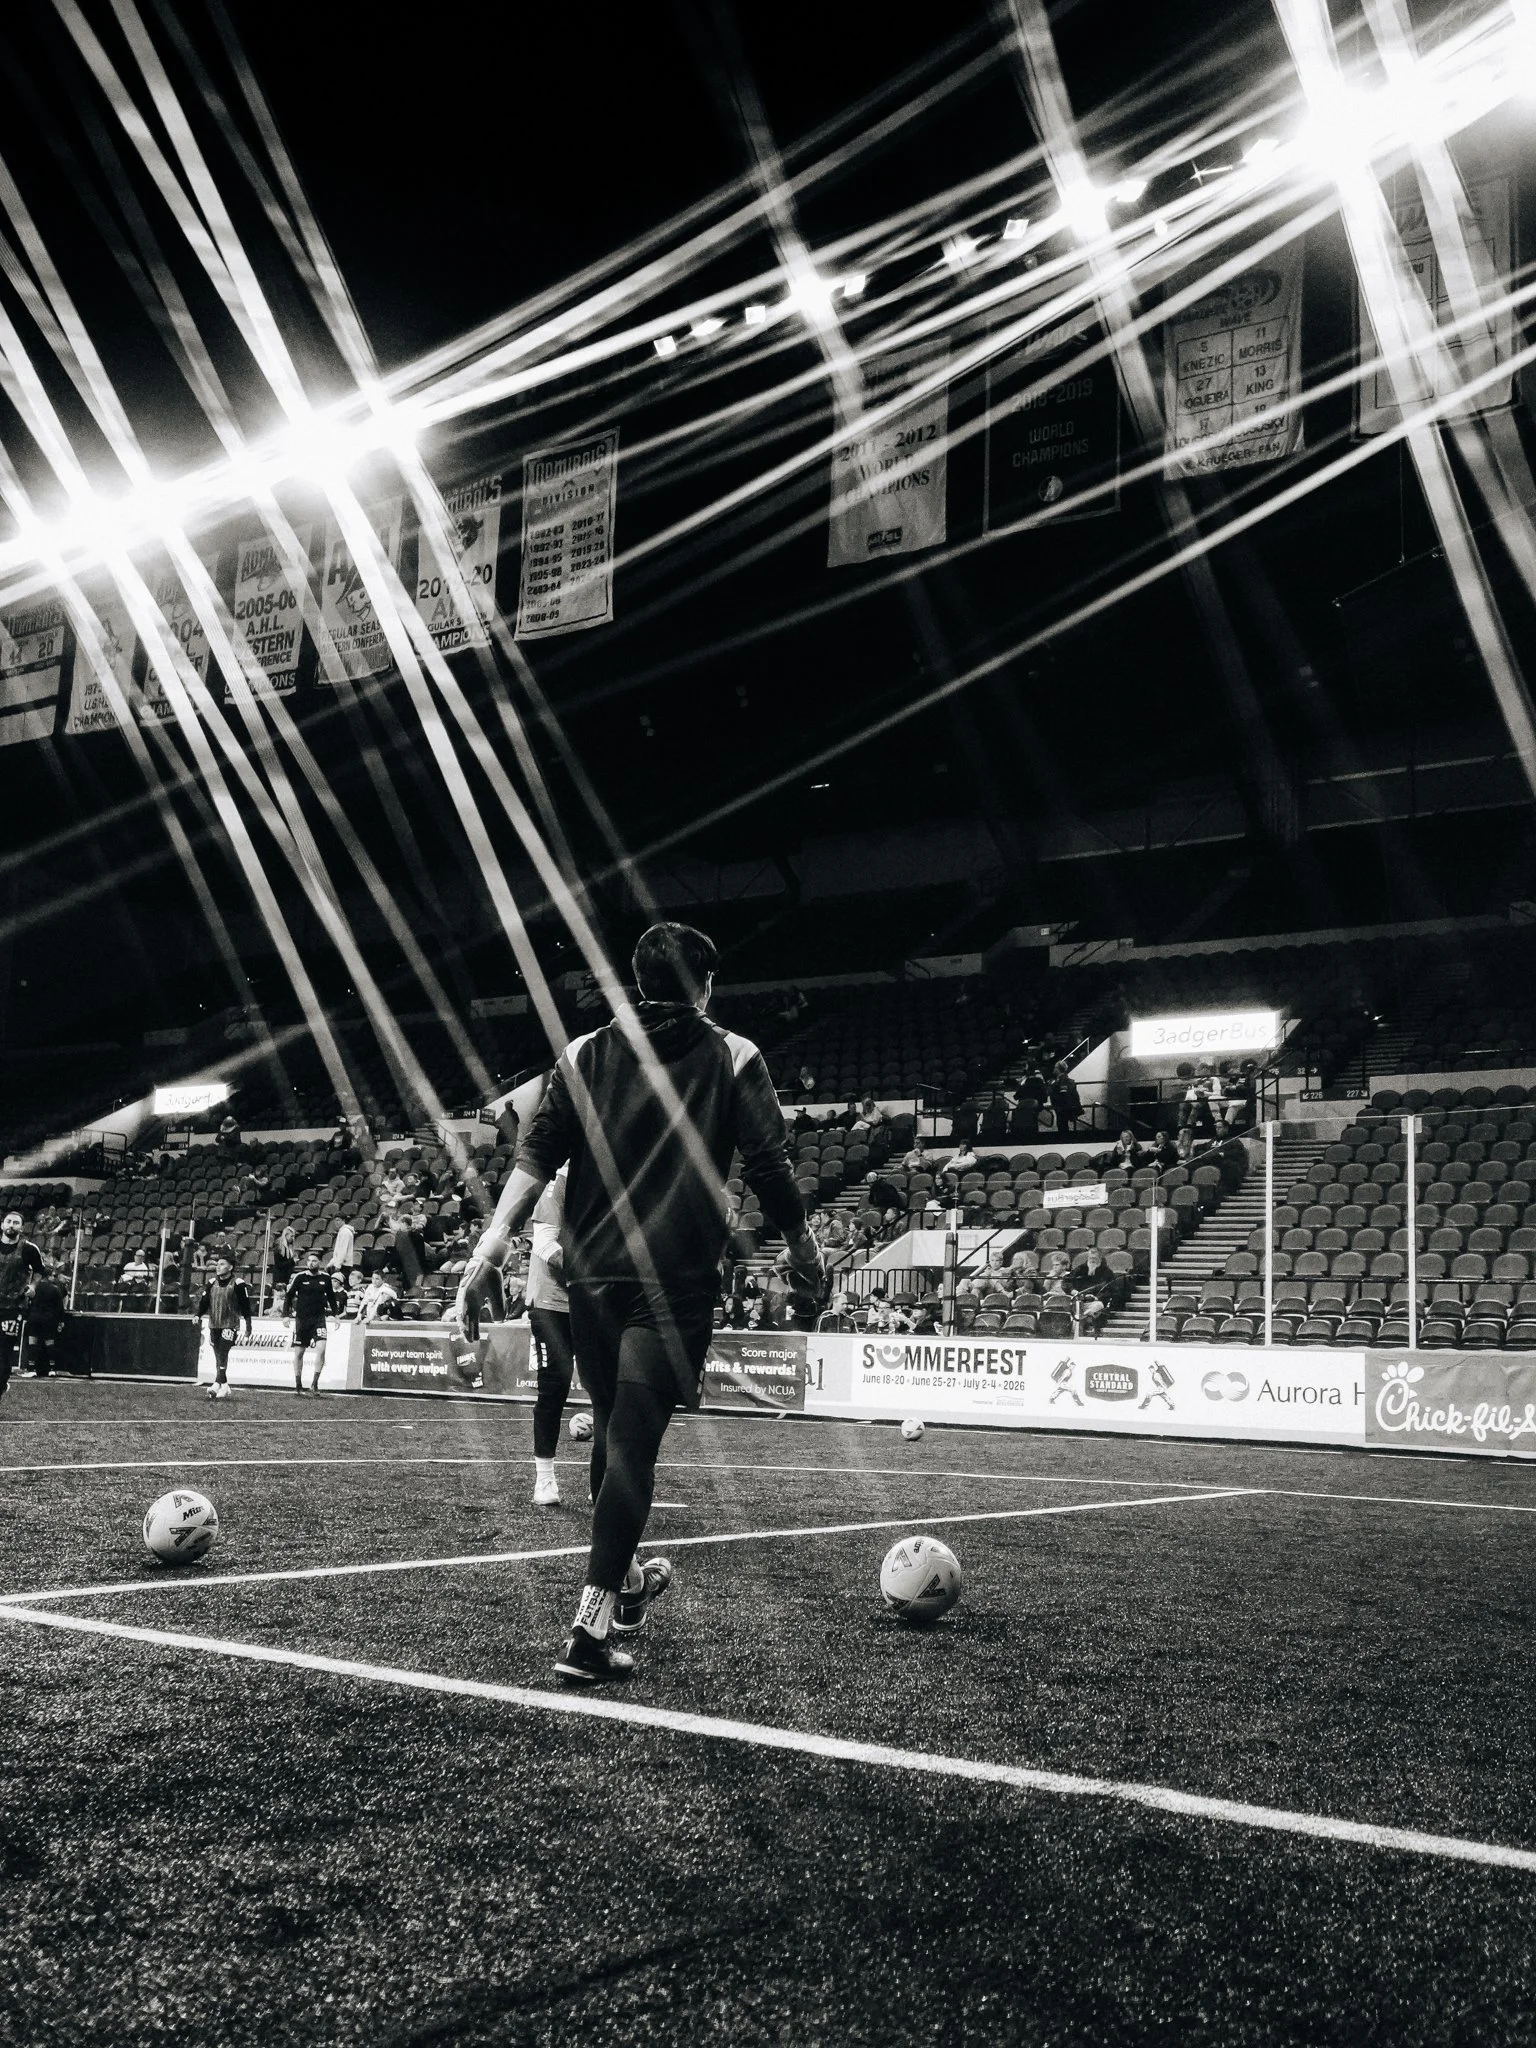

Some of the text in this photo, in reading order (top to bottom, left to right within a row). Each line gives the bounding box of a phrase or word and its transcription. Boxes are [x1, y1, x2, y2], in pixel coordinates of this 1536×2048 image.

[1246, 379, 1274, 395] KING
[895, 424, 937, 447] 2012
[1029, 421, 1074, 444] WORLD
[1012, 438, 1089, 468] CHAMPIONS
[235, 589, 297, 620] 2005-06
[245, 615, 284, 637] A.H.L.
[371, 1348, 443, 1361] Show your team spirit
[741, 1347, 798, 1361] Score major
[370, 1361, 448, 1377] with every swipe!
[732, 1361, 742, 1374] &
[744, 1363, 797, 1376] rewards!
[862, 1374, 1025, 1391] June 18-20 June 25-27 July 2-4 2026
[1089, 1380, 1134, 1390] STANDARD
[1093, 1372, 1131, 1382] CENTRAL
[720, 1382, 796, 1396] Insured by NCUA
[1257, 1379, 1342, 1405] Aurora
[1375, 1377, 1536, 1442] Chick-fil-A
